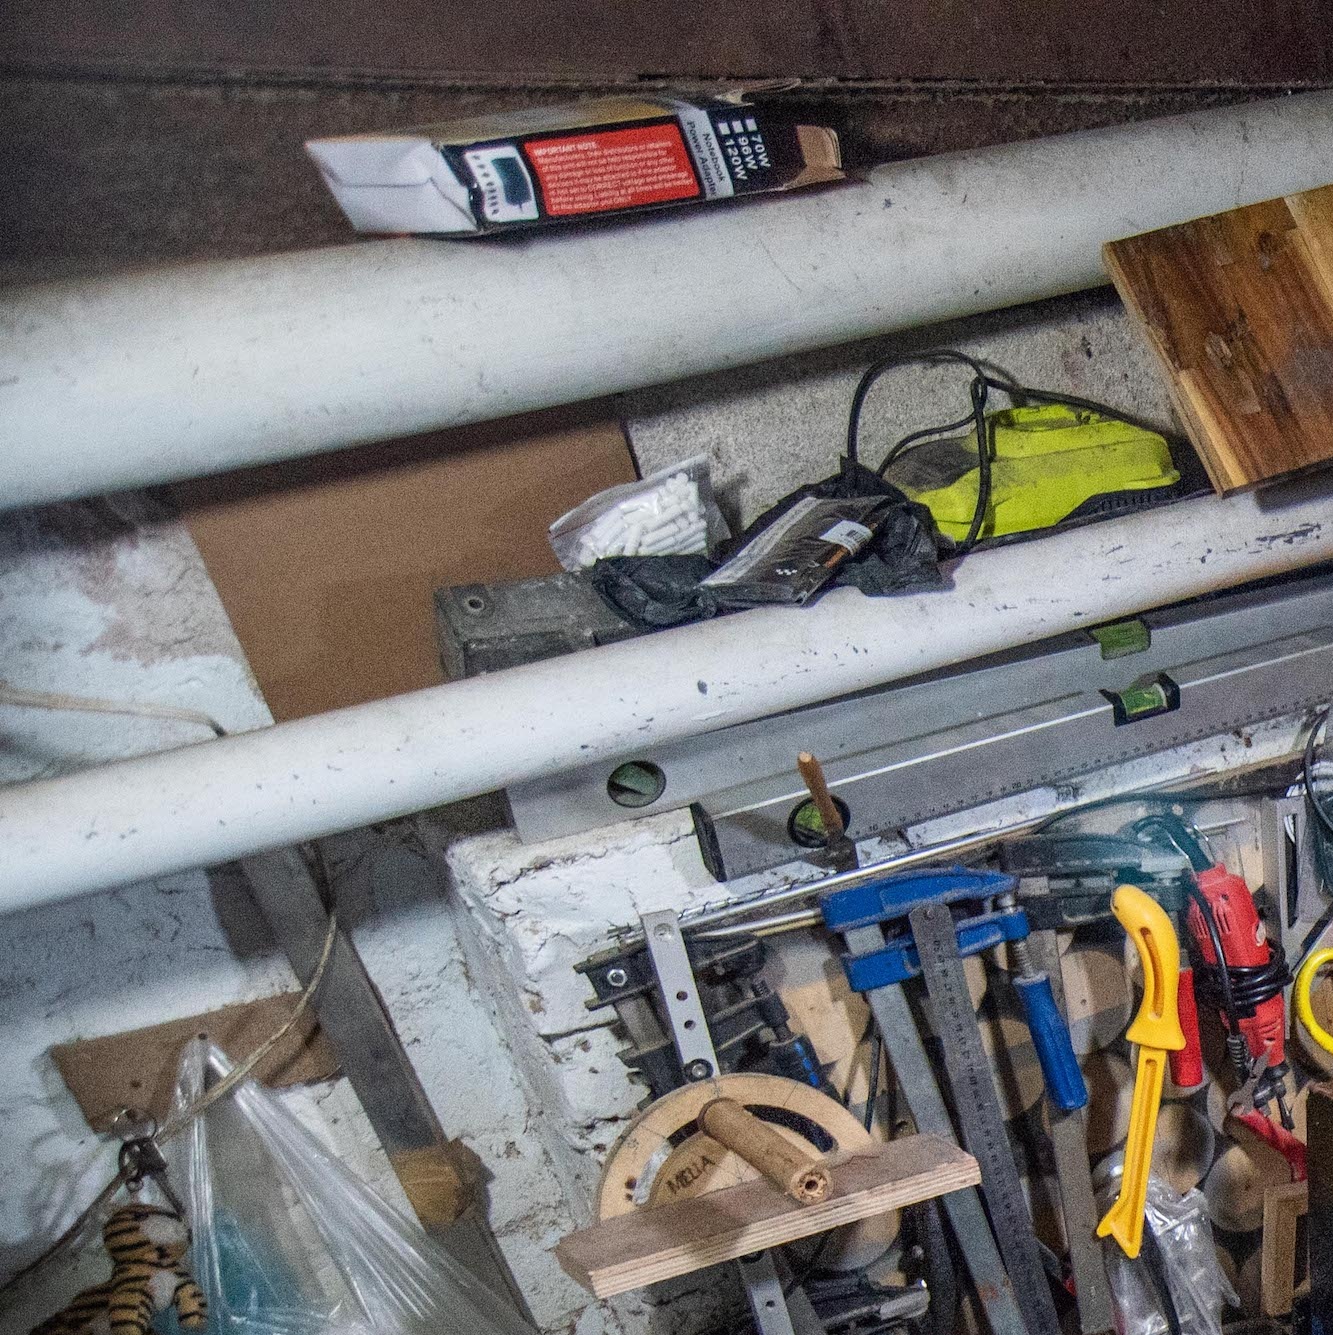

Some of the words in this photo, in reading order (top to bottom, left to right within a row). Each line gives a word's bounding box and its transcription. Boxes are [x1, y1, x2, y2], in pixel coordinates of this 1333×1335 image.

[687, 121, 704, 155] Power
[700, 157, 718, 198] Adapter
[702, 133, 726, 182] Notebook
[725, 139, 748, 180] 120W
[739, 137, 758, 170] 96W
[752, 134, 771, 168] 70W
